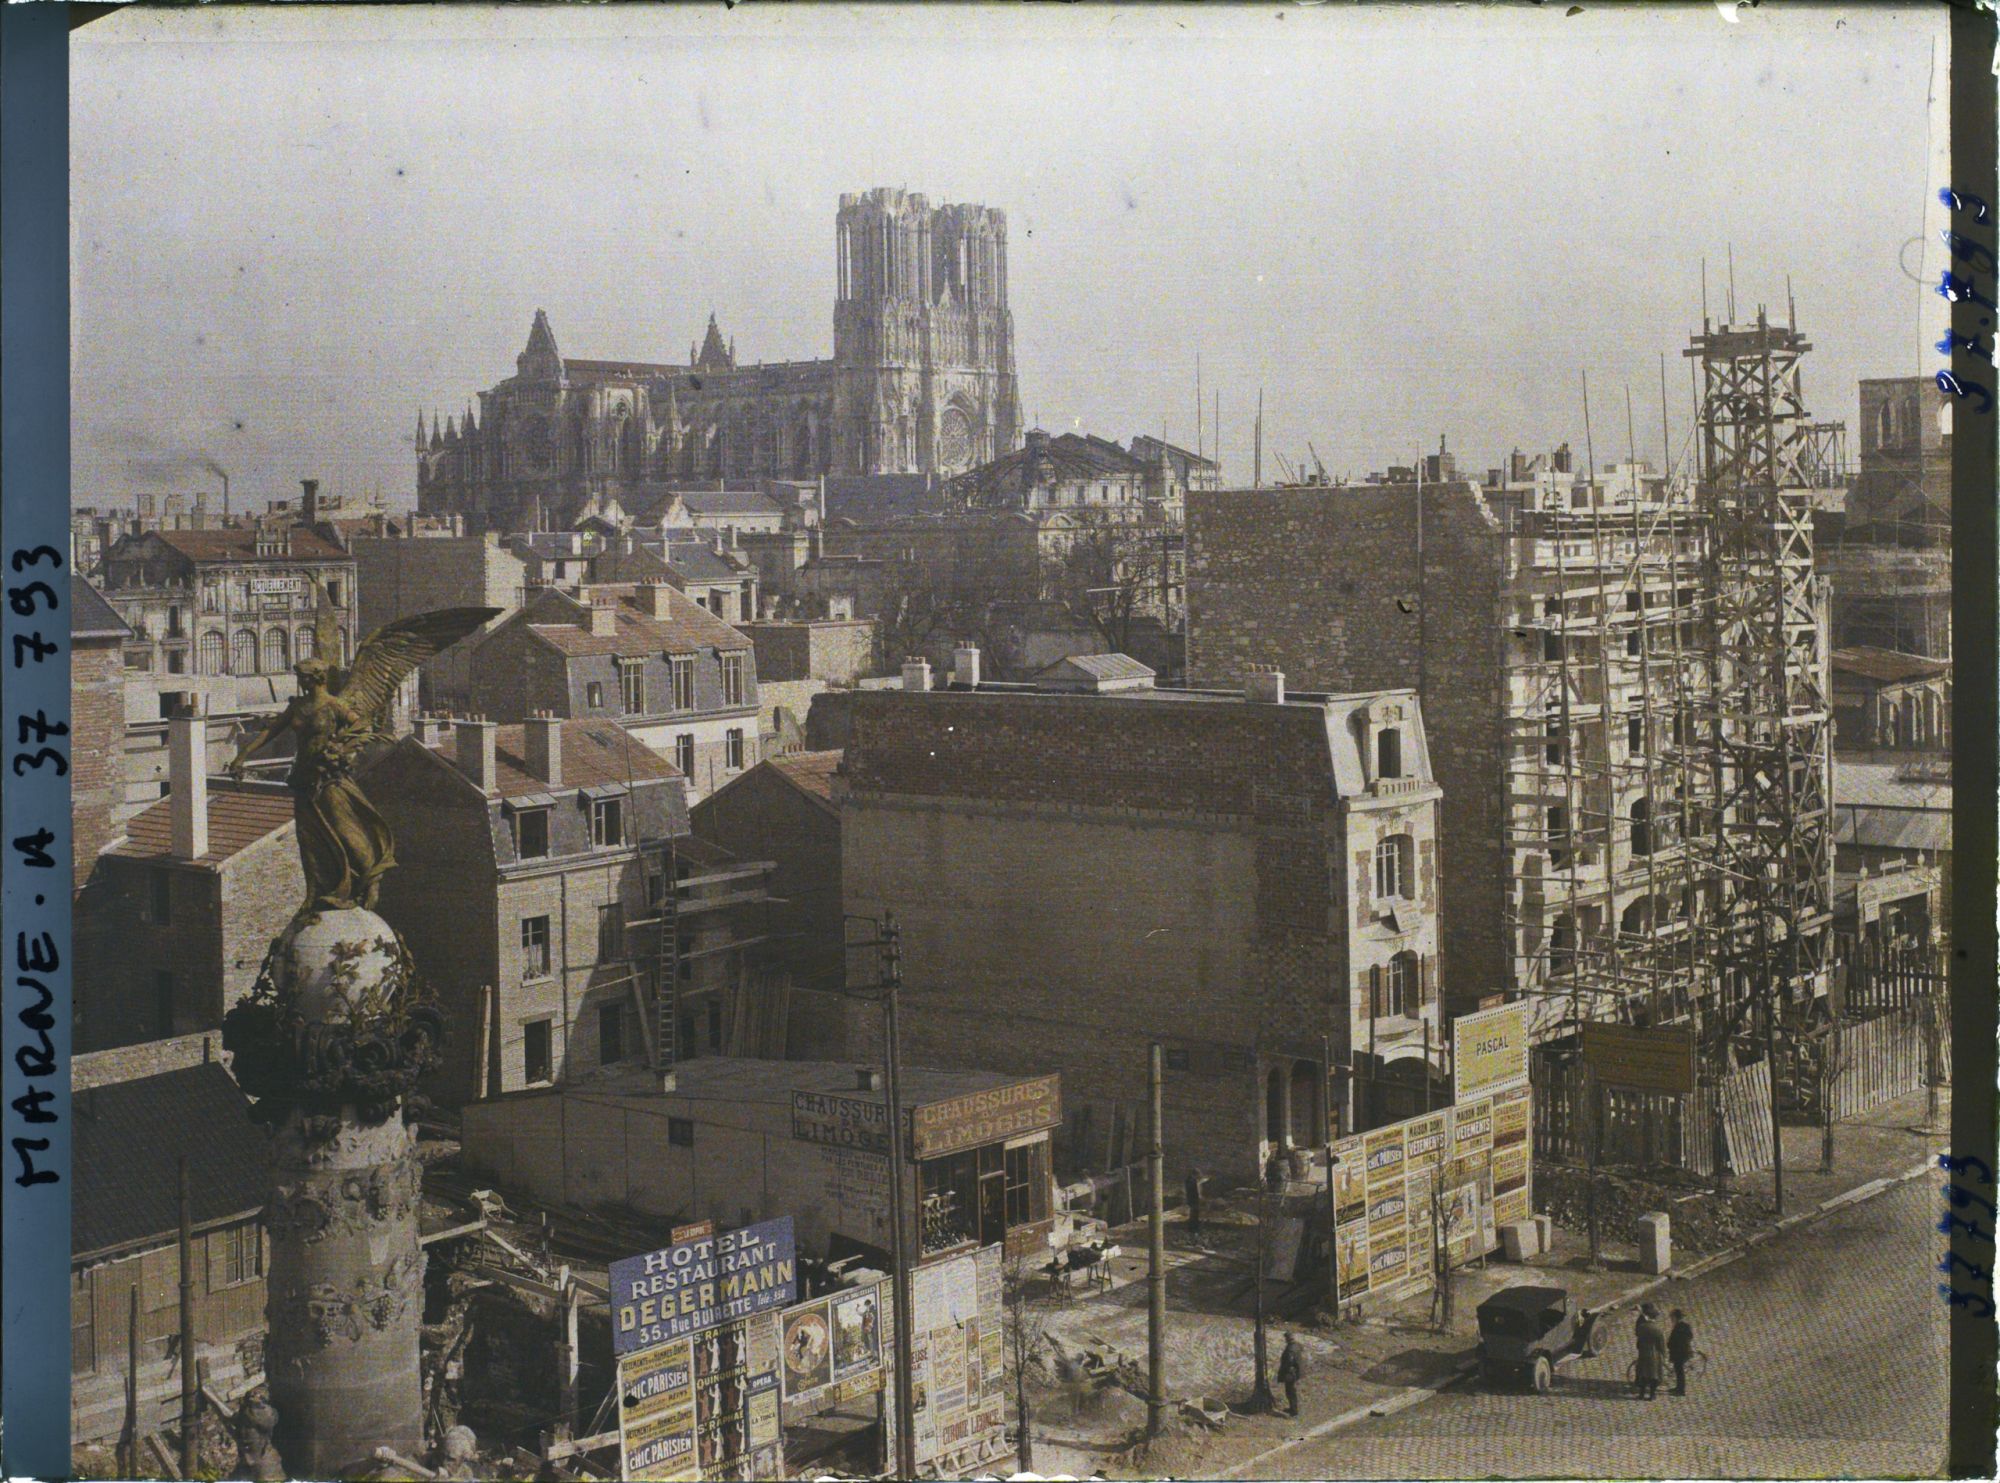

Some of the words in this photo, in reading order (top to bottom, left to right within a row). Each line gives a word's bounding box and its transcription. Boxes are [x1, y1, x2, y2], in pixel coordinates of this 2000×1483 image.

[8, 545, 62, 668] 793
[13, 709, 69, 778] 37
[1476, 1036, 1509, 1057] PASCAL
[795, 1093, 909, 1128] CHAUSSURS
[922, 1078, 1051, 1125] CHAUSSURES
[796, 1120, 908, 1152] LIMOGE
[923, 1104, 1051, 1153] LIMOGES
[644, 1230, 760, 1275] HOTEL
[631, 1243, 777, 1301] RESTAURANT
[620, 1259, 793, 1332] DEGERMANN
[671, 1318, 690, 1334] Rue
[692, 1298, 752, 1329] BUIRETTE
[648, 1371, 689, 1396] PARISIEN
[697, 1366, 747, 1391] QUINQUINA
[752, 1375, 772, 1389] OPERA
[709, 1410, 744, 1430] RAPHAE
[629, 1447, 651, 1470] CHIC
[651, 1437, 692, 1463] PARISIEN
[702, 1453, 750, 1478] QUINQUINA
